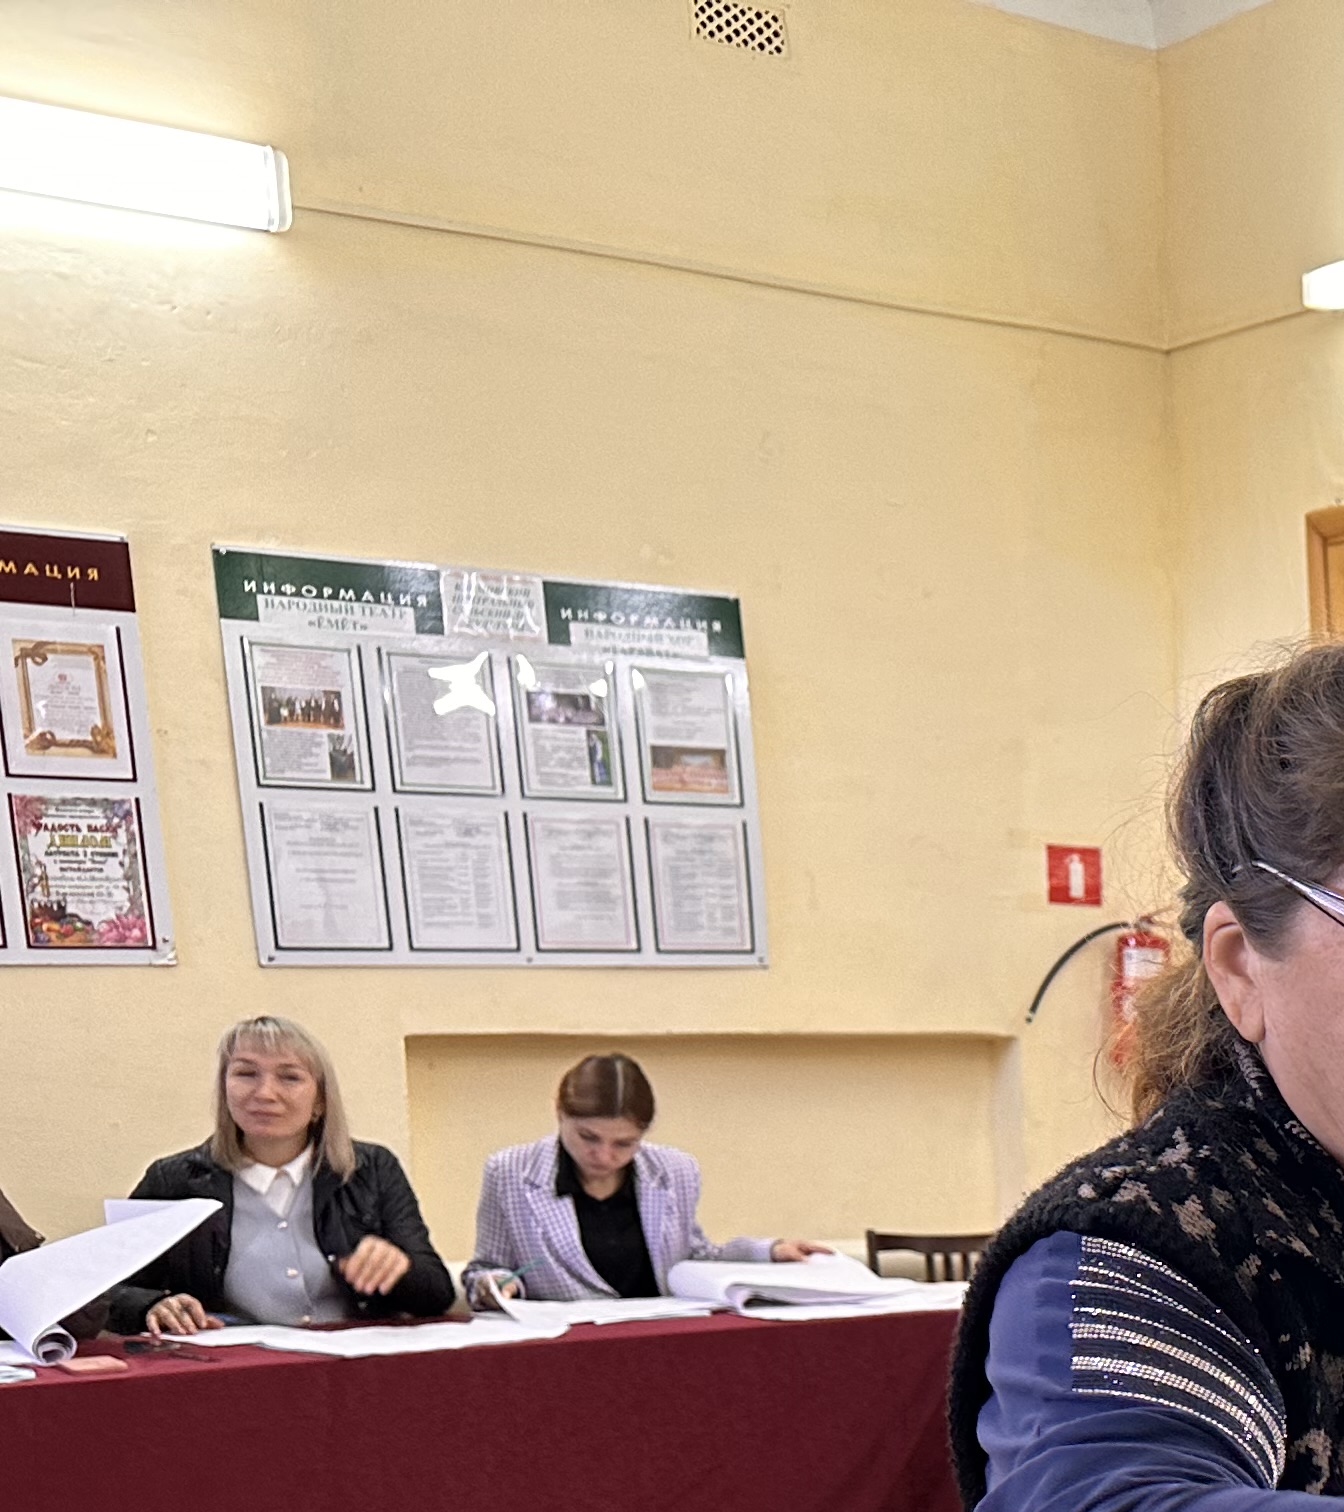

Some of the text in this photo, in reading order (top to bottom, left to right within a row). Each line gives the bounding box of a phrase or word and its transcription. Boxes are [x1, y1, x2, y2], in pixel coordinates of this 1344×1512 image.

[243, 580, 428, 607] ИНФОРМАЦИЯ
[263, 598, 407, 621] НАРОДНЫЙ ТЕАТР
[559, 607, 722, 633] ИНФОРМАЦИЯ
